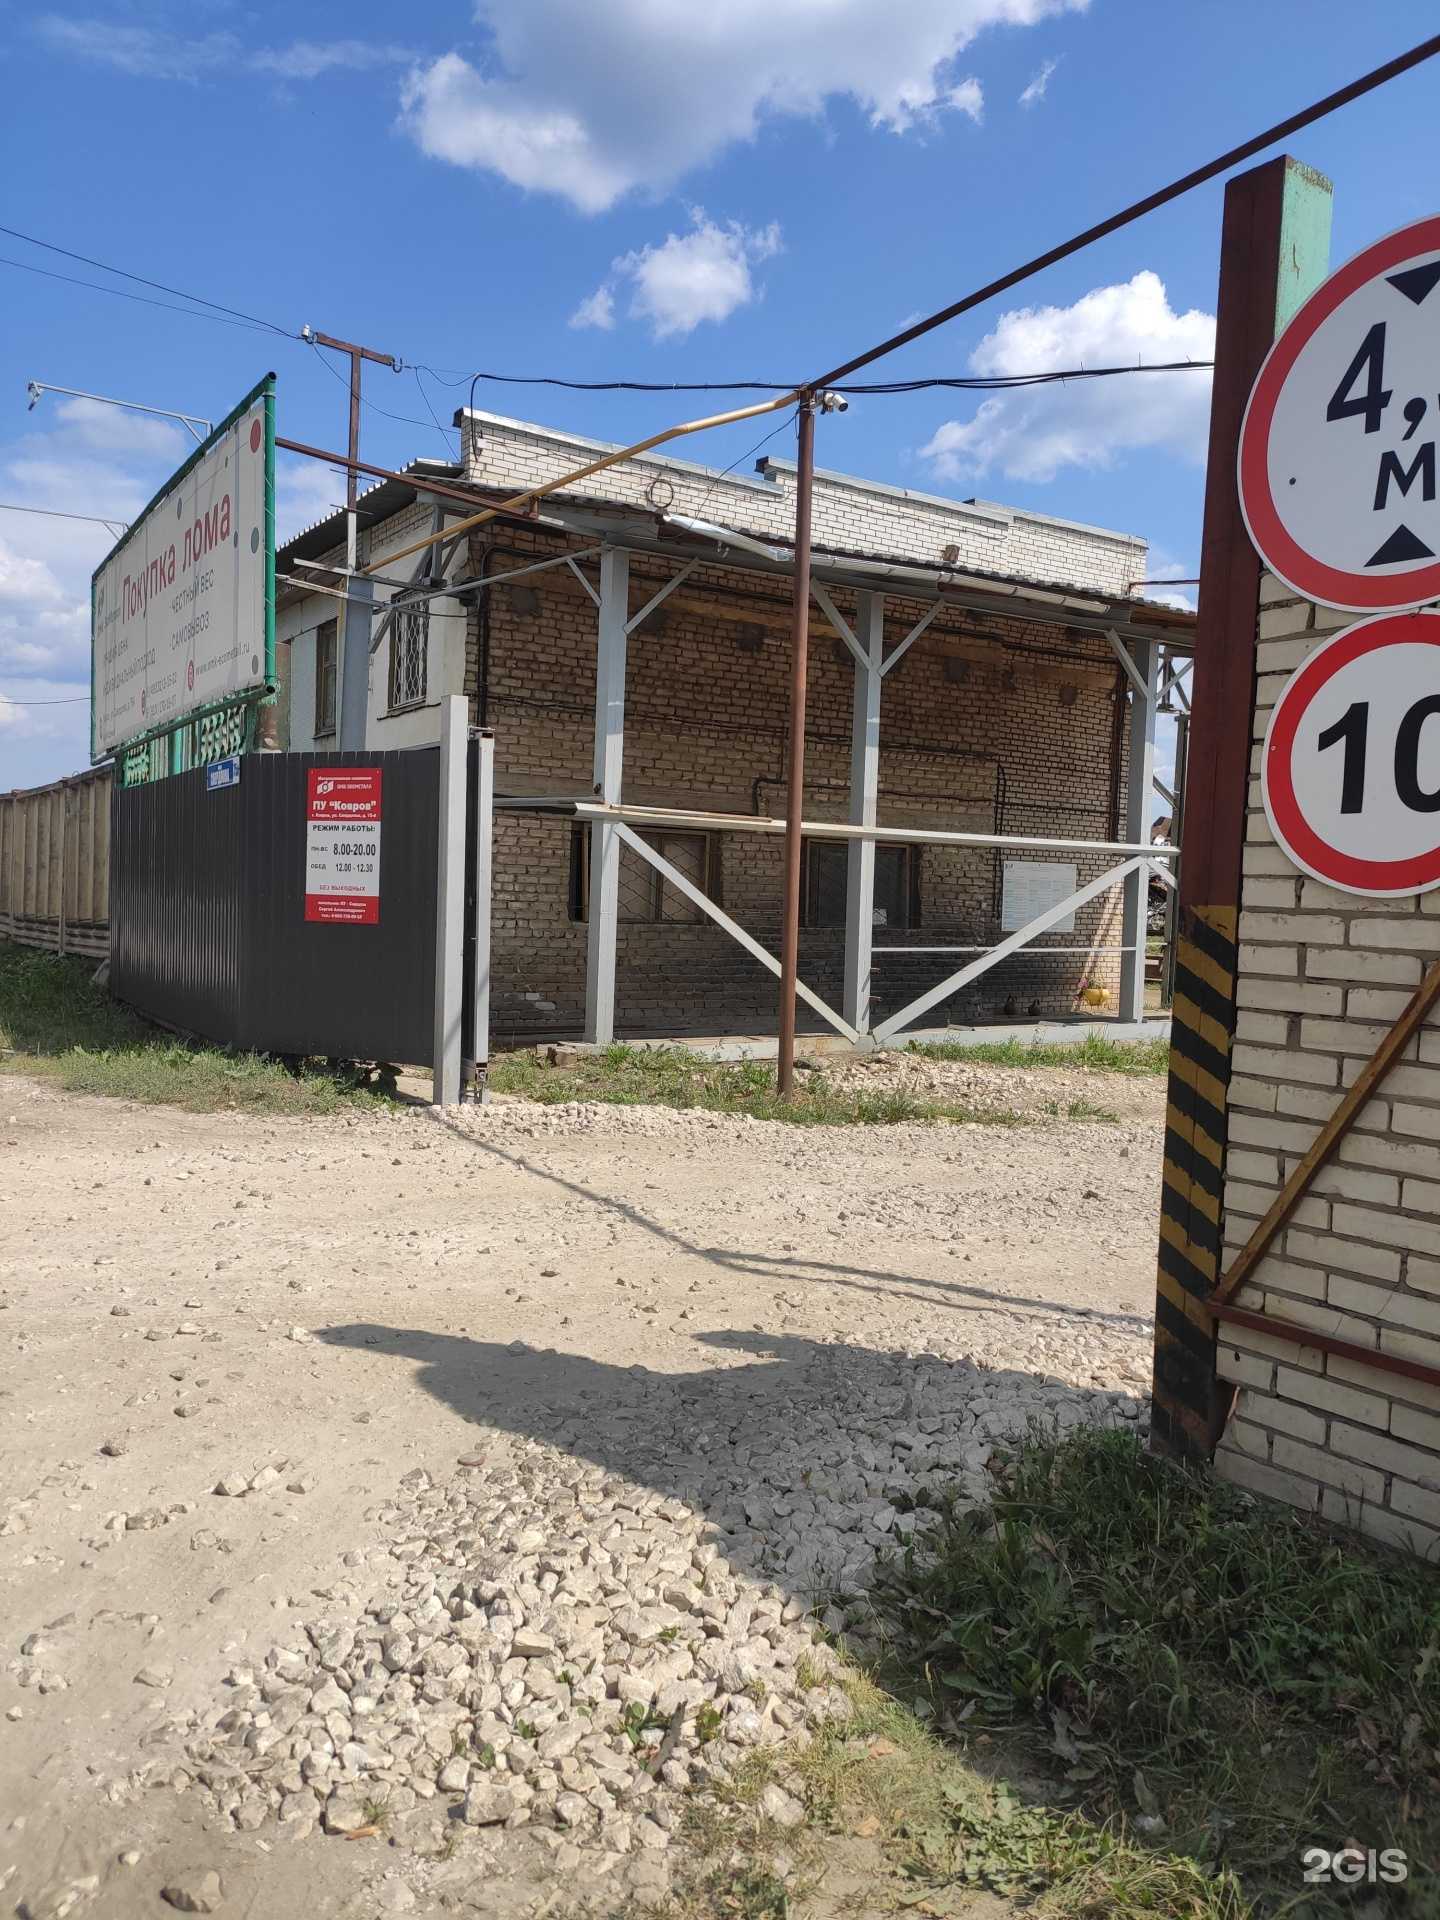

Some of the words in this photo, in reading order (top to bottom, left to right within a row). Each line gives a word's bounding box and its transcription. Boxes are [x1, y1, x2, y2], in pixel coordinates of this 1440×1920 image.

[1326, 321, 1440, 442] 4,
[122, 543, 176, 625] Покупка
[182, 493, 231, 573] лома
[200, 568, 215, 593] ВЕС
[171, 610, 210, 650] САМОВЫВОЗ
[312, 800, 327, 811] ПУ
[333, 843, 376, 856] 8.00-20.00
[310, 863, 327, 871] ОБЕД
